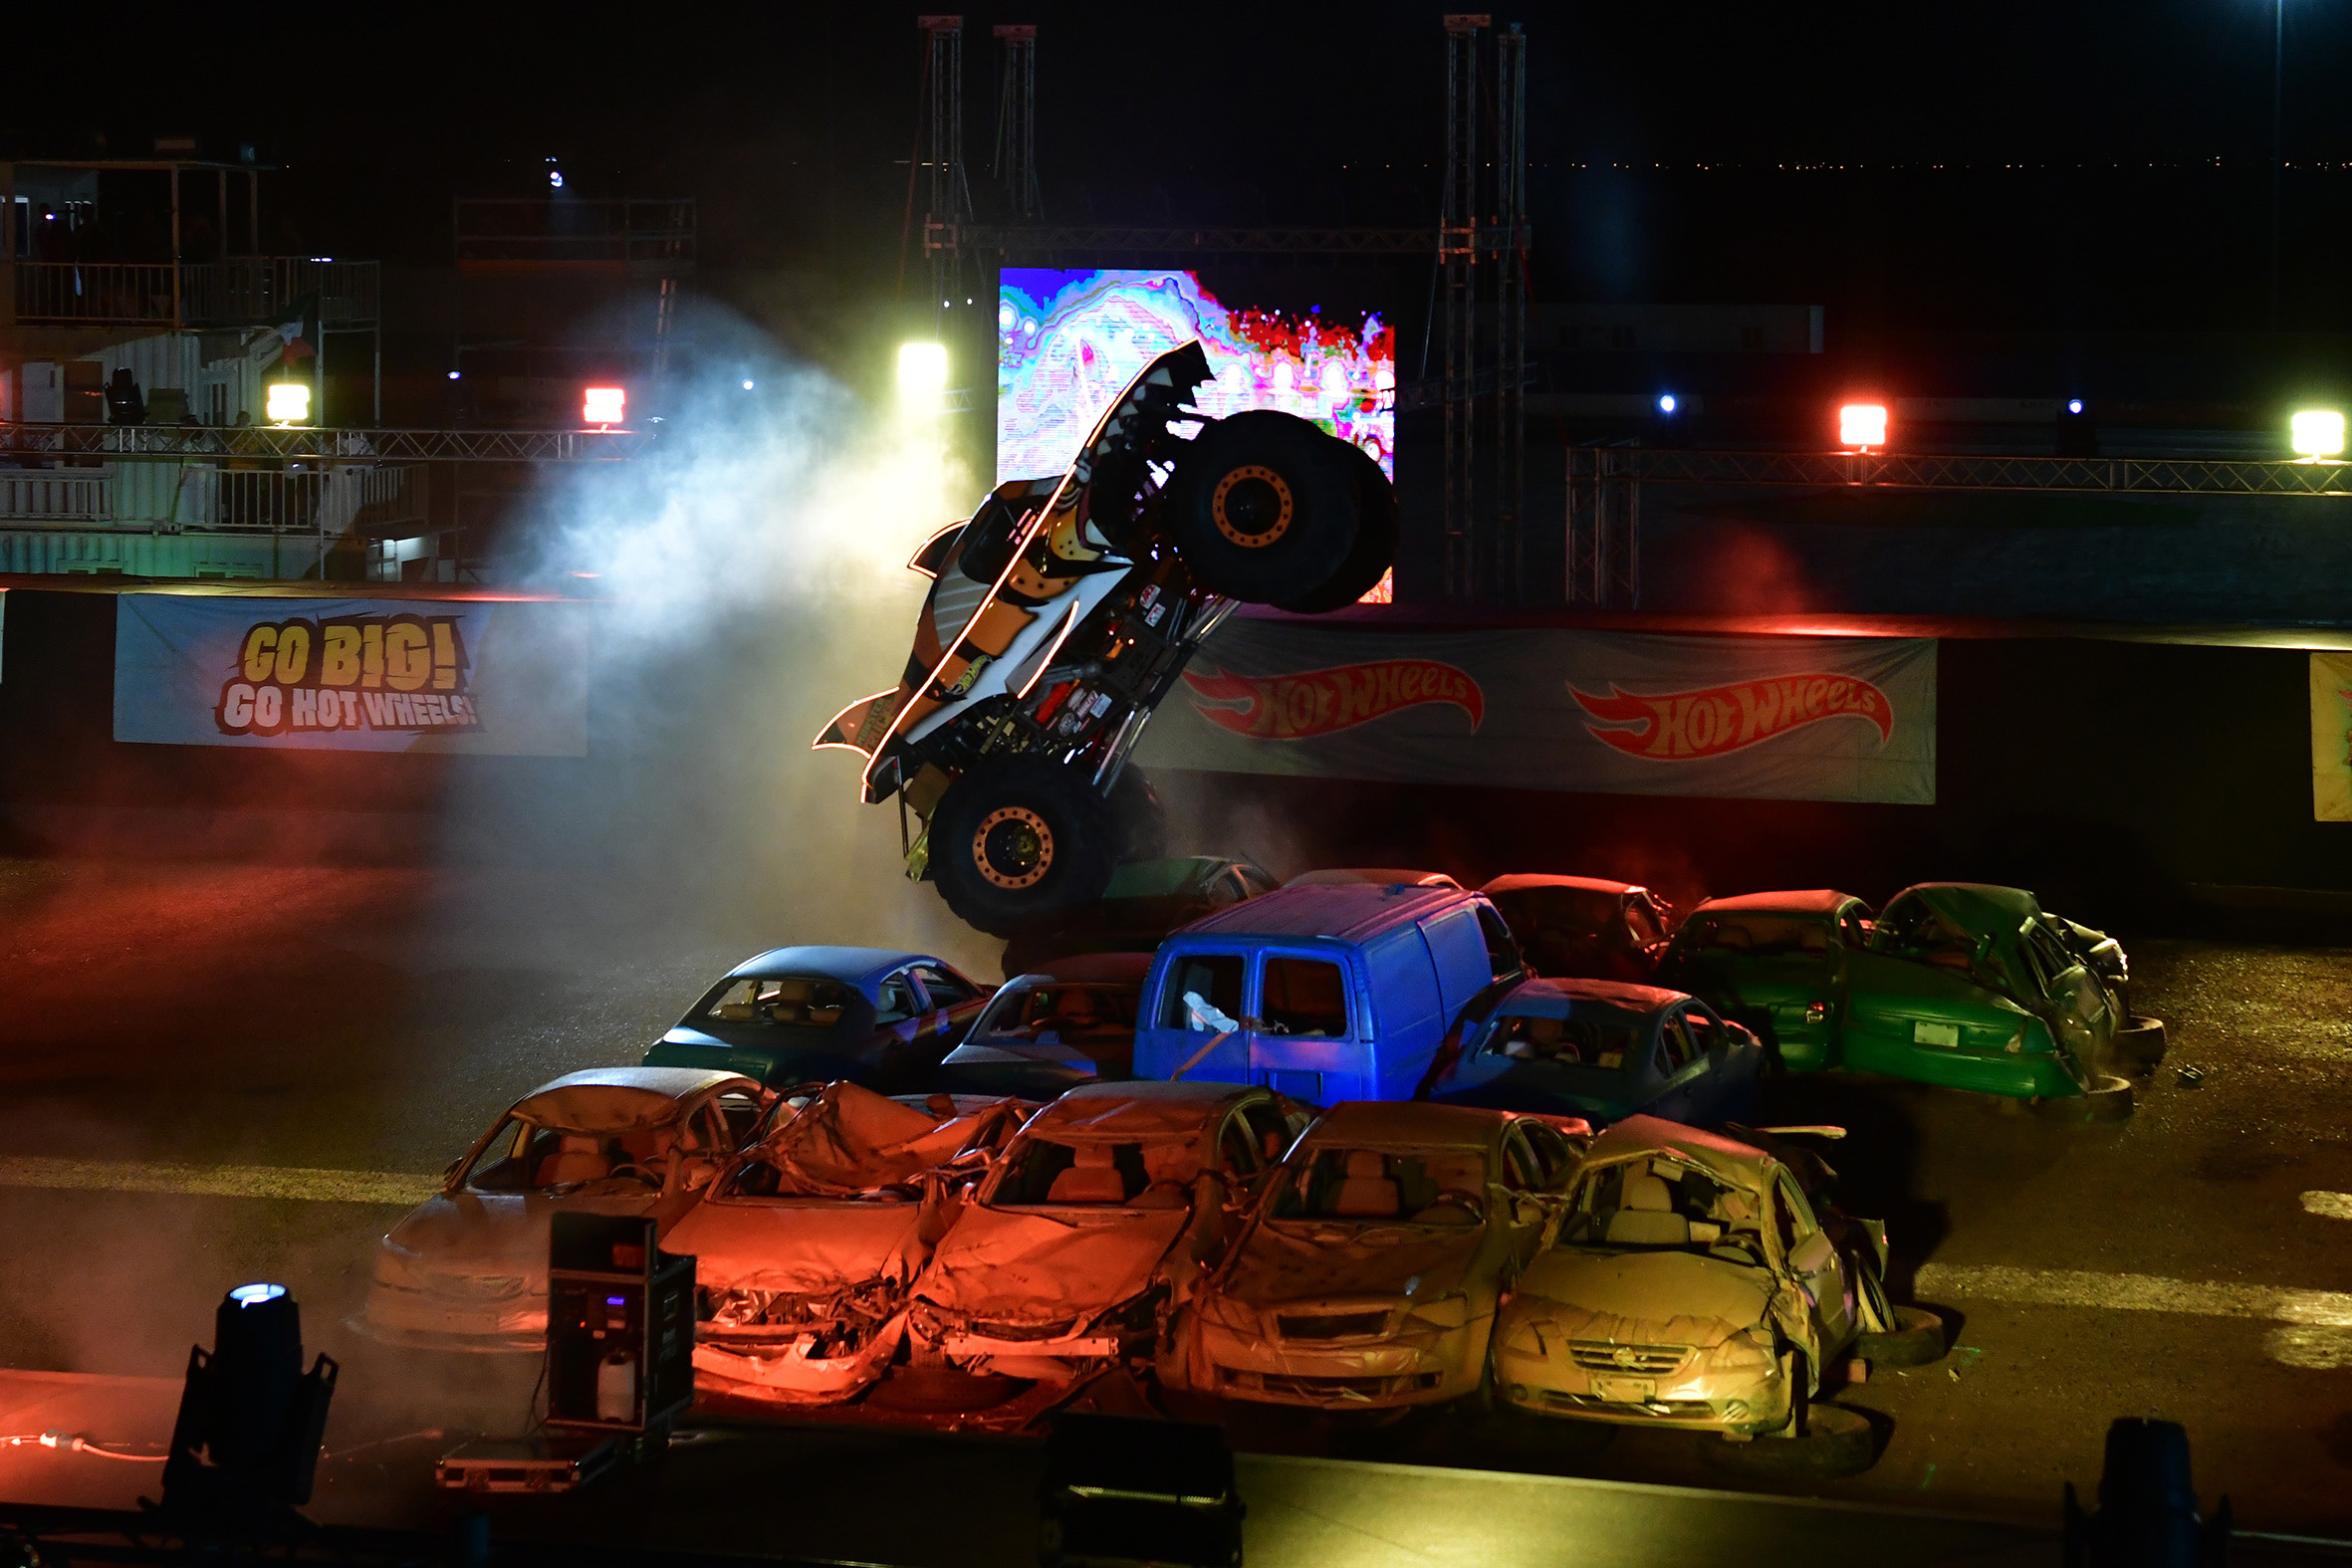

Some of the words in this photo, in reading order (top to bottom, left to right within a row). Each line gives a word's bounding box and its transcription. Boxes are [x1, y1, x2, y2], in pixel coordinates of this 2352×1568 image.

[244, 625, 311, 685] GO
[320, 622, 457, 691] BIG!
[223, 683, 283, 728] GO
[291, 688, 358, 727] HOT
[362, 692, 479, 726] WHEELS!
[1248, 679, 1336, 735] HOT
[1641, 695, 1739, 756] HOT
